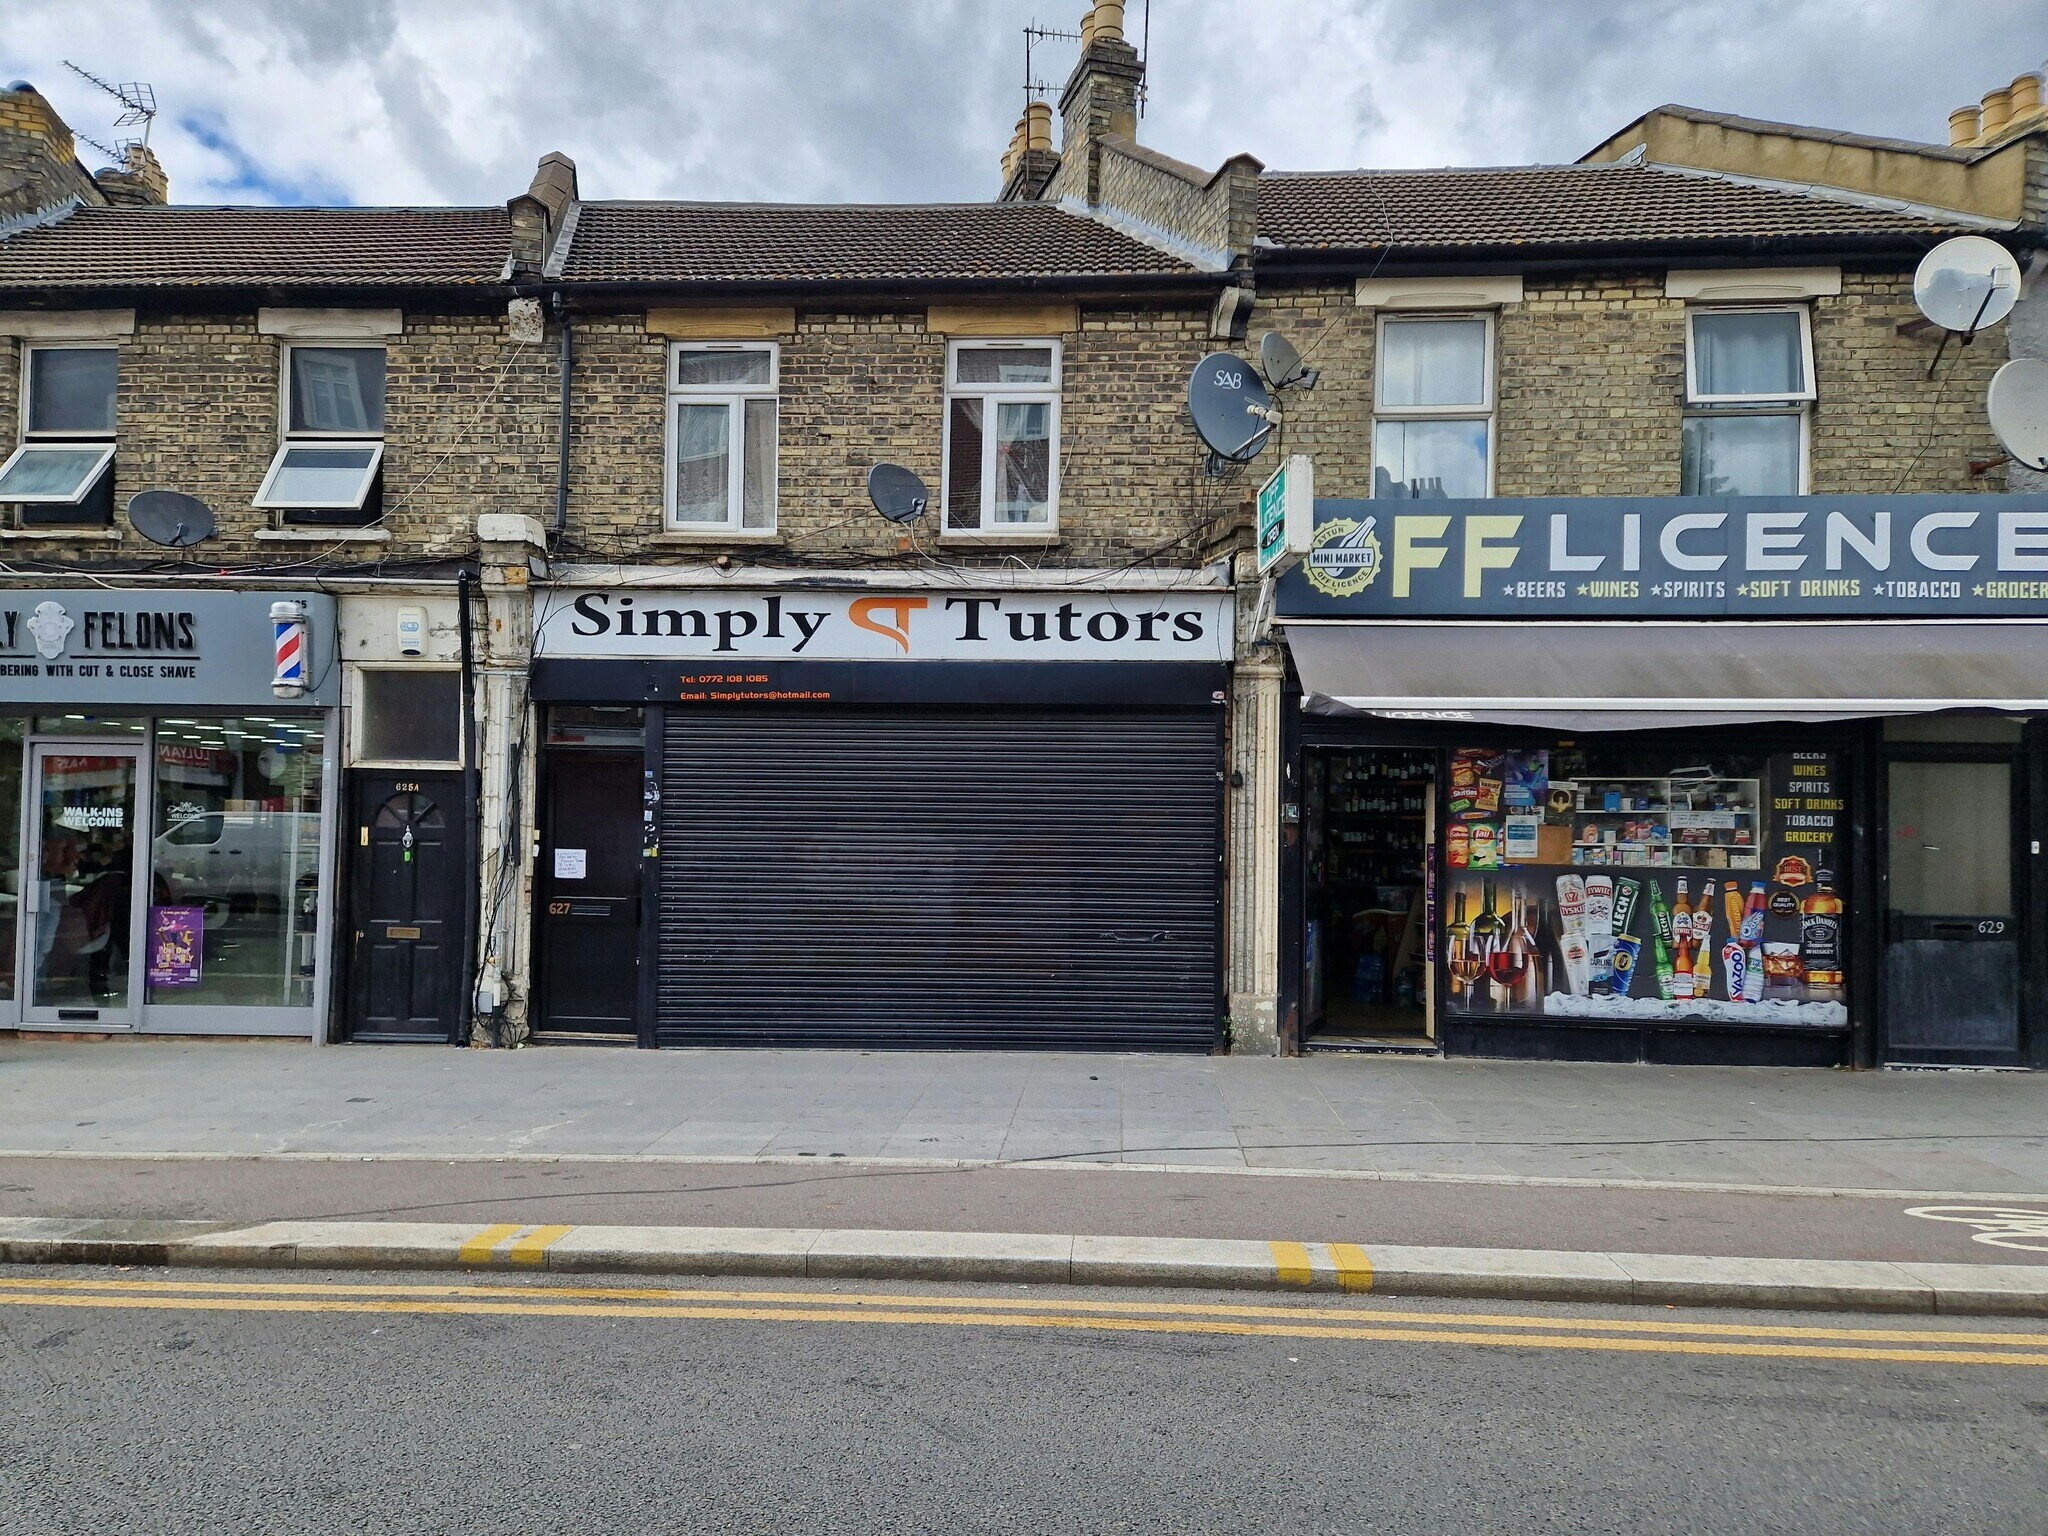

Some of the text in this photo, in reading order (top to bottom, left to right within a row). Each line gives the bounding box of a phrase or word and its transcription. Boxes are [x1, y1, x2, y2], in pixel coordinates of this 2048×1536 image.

[1213, 369, 1242, 389] SAB
[1317, 526, 1345, 545] AYTUN
[1550, 511, 2048, 571] LICENCE
[1312, 552, 1372, 564] MINI MARKET
[1317, 570, 1369, 588] OFF LICENCE
[1516, 581, 1566, 598] BEERS
[1590, 580, 1640, 598] WINES
[1663, 580, 1726, 598] SPIRITS
[1750, 580, 1791, 598] SOFT
[1800, 579, 1860, 597] DRINKS
[1886, 581, 1961, 599] TOBACCO
[571, 592, 832, 653] Simply
[944, 597, 1205, 642] Tutors
[0, 611, 196, 650] Y FELONS
[46, 664, 73, 677] WITH
[79, 665, 100, 677] CUT
[105, 665, 114, 677] &
[120, 665, 154, 678] CLOSE
[160, 665, 196, 678] SHAVE
[680, 674, 769, 683] Tel: 0772 108 1085
[680, 692, 707, 700] Email:
[1793, 765, 1826, 776] WINES
[395, 782, 420, 791] 625A
[1789, 782, 1830, 793] SPIRITS
[1453, 789, 1478, 797] Skittles
[1774, 798, 1844, 810] SOFT DRINKS
[63, 806, 124, 818] WALK-INS
[63, 817, 124, 828] WELCOME
[1785, 815, 1834, 827] TOBACCO
[1785, 831, 1834, 843] GROCERY
[549, 903, 571, 914] 627
[1615, 897, 1630, 927] LECH
[1978, 920, 2004, 934] 629
[1731, 951, 1744, 996] YAZOO
